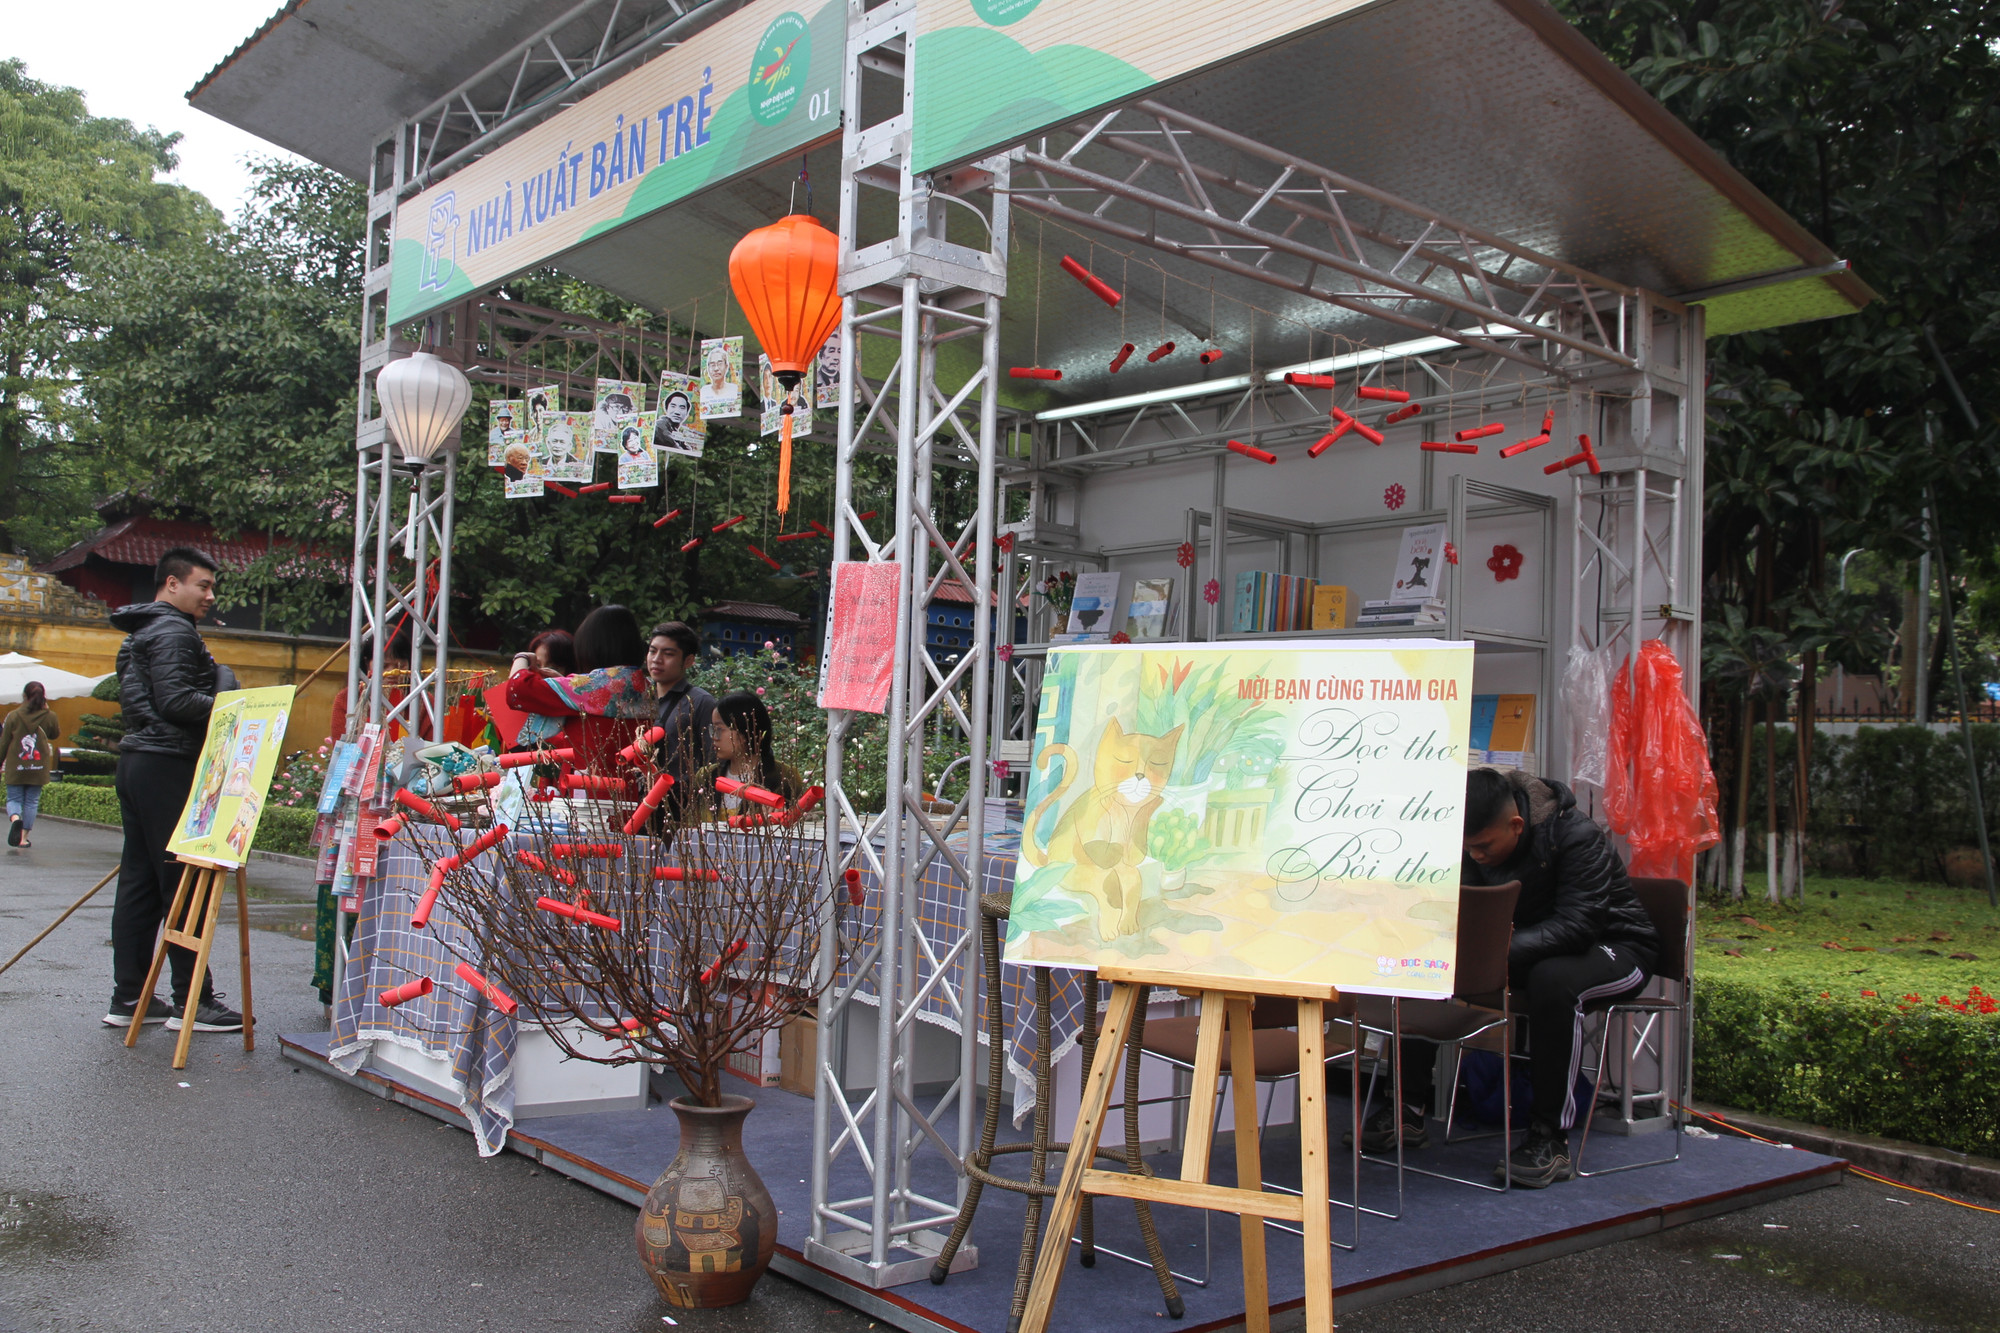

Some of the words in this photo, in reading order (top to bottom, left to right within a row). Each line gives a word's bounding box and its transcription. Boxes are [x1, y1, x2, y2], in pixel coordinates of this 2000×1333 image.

[808, 88, 831, 121] 01
[466, 181, 514, 257] NHÀ
[518, 139, 584, 233] XUẤT
[588, 113, 648, 200] BẢN
[656, 65, 714, 166] TRẺ
[1237, 675, 1269, 700] MỜI
[1274, 679, 1311, 704] BẠN
[1316, 675, 1364, 700] CÙNG
[1370, 679, 1422, 700] THAM
[1427, 679, 1458, 700] GIA
[1276, 707, 1400, 764] Đọc
[1403, 730, 1458, 761] thơ
[1294, 764, 1385, 823] Chơi
[1399, 790, 1455, 822] thơ
[1266, 828, 1403, 902] Bói
[1394, 851, 1451, 884] thơ
